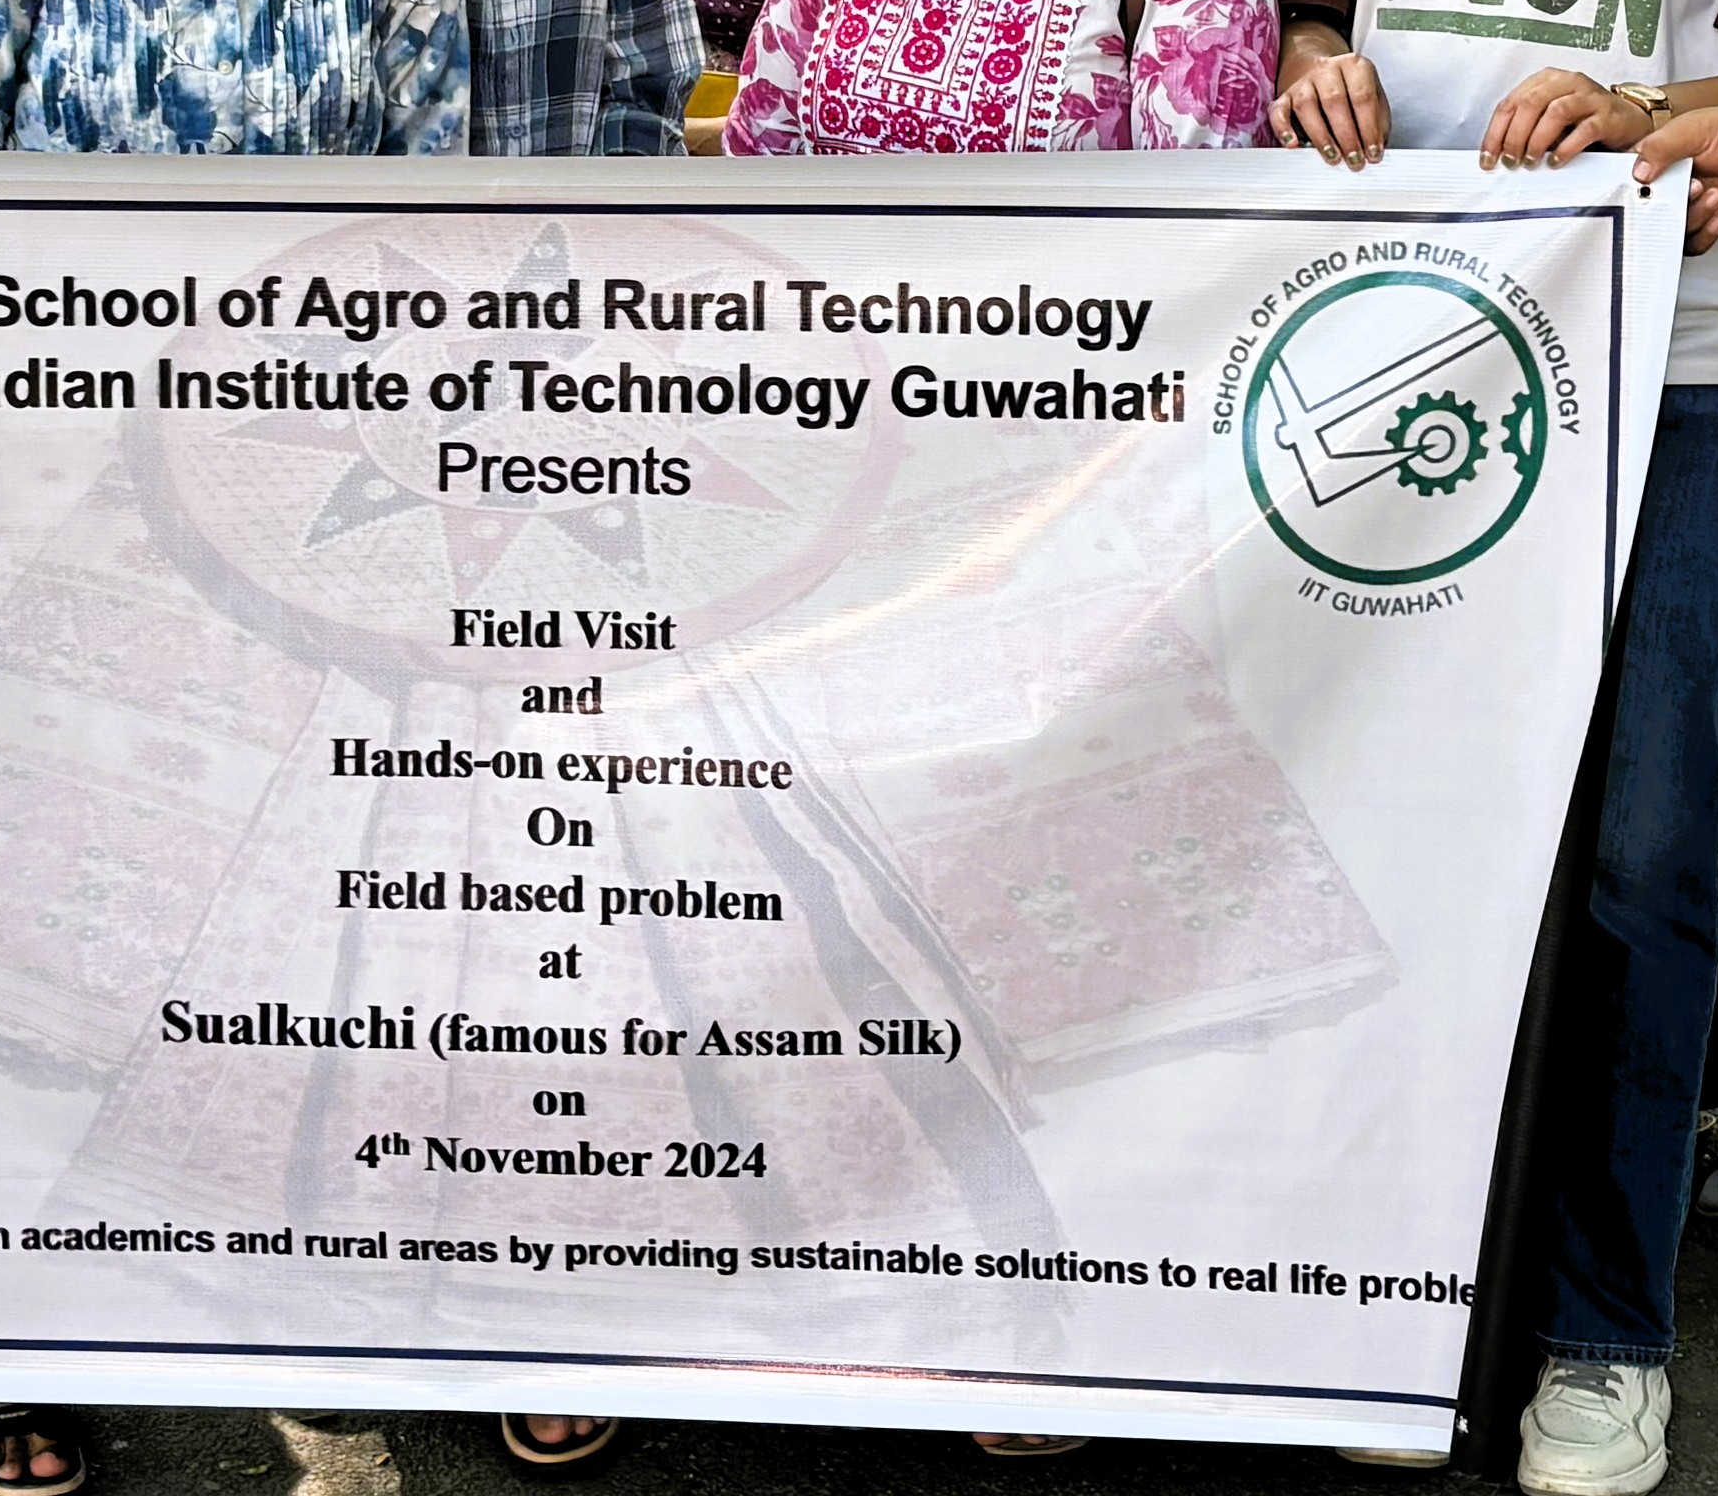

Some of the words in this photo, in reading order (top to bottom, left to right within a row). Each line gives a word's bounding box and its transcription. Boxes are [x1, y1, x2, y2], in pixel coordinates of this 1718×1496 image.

[219, 276, 281, 328] of
[295, 277, 447, 342] Agro
[468, 279, 580, 331] and
[604, 279, 766, 332] Rural
[787, 281, 1153, 349] Technology
[1213, 336, 1259, 434] SCHOOL
[1251, 294, 1279, 329] OF
[1281, 251, 1348, 301] AGRO
[1355, 241, 1408, 266] AND
[1413, 243, 1491, 283] RURAL
[1496, 273, 1580, 434] TECHNOLOGY
[159, 359, 409, 411] Institute
[429, 360, 494, 411] of
[509, 361, 871, 429] Technology
[892, 366, 1184, 423] Guwahati
[438, 441, 691, 496] Presents
[1297, 577, 1330, 604] IIT
[1331, 583, 1465, 617] GUWAHATI
[451, 609, 562, 649] Field
[575, 611, 678, 650] Visit
[522, 677, 604, 715] and
[331, 739, 543, 780] Hands-on
[558, 747, 793, 794] experience
[528, 807, 594, 847] On
[337, 871, 447, 911] Field
[461, 873, 585, 913] based
[600, 880, 784, 925] problem
[540, 944, 583, 979] at
[162, 1000, 416, 1050] Sualkuchi
[429, 1014, 607, 1061] (famous
[622, 1018, 688, 1057] for
[696, 1021, 844, 1057] Assam
[859, 1019, 962, 1064] Silk)
[533, 1091, 587, 1117] on
[355, 1132, 411, 1169] 4th
[424, 1137, 653, 1177] November
[665, 1142, 768, 1179] 2024
[22, 1222, 216, 1253] academics
[227, 1228, 293, 1256] and
[305, 1232, 388, 1259] rural
[400, 1240, 499, 1263] areas
[510, 1236, 555, 1271] by
[566, 1239, 739, 1275] providing
[751, 1241, 963, 1275] sustainable
[976, 1249, 1149, 1286] solutions
[1159, 1258, 1197, 1288] to
[1209, 1263, 1277, 1293] real
[1291, 1264, 1347, 1297] life
[1360, 1271, 1477, 1307] proble
